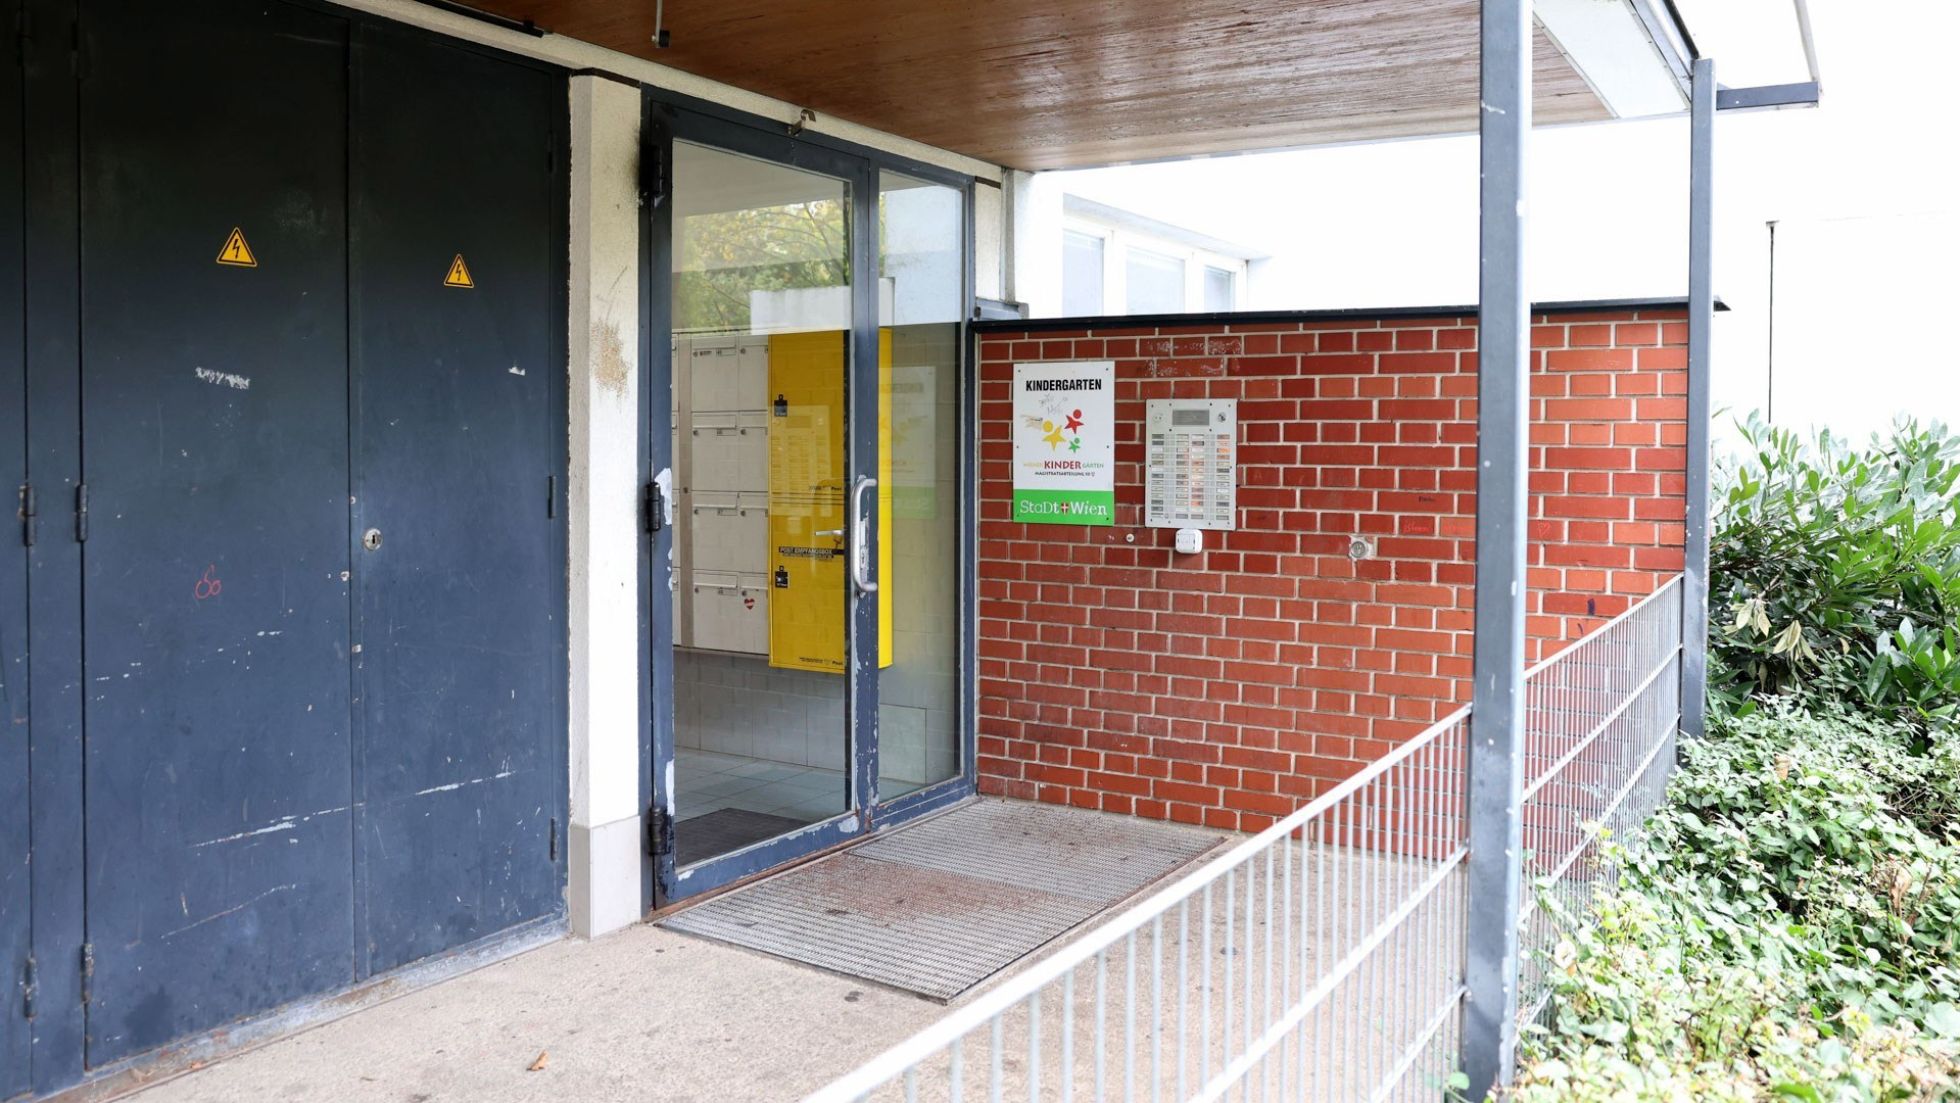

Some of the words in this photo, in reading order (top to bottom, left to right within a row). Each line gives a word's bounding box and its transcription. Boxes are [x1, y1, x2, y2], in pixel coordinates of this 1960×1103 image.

[1026, 379, 1101, 391] KINDERGARTEN
[1044, 461, 1082, 469] KINDER
[1070, 501, 1107, 515] Wien
